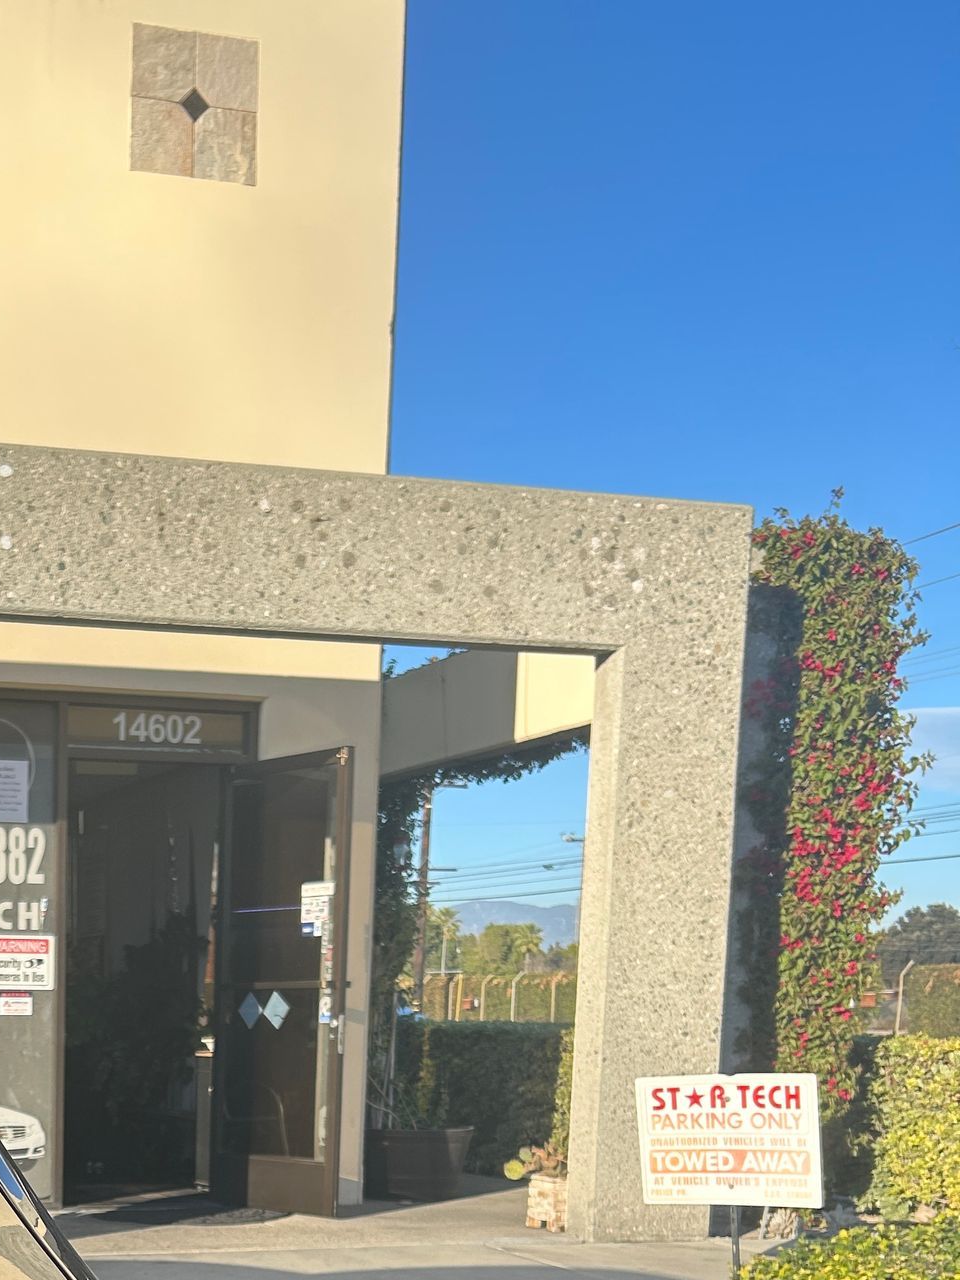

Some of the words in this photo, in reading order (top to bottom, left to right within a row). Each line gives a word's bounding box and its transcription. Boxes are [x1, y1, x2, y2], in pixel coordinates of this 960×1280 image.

[112, 712, 202, 744] 14602
[32, 971, 45, 983] Use
[736, 1085, 801, 1110] TECH
[651, 1112, 744, 1131] PARKING
[749, 1112, 802, 1131] ONLY
[650, 1137, 718, 1147] UNAUTHORIZED
[723, 1137, 765, 1147] VEHICLES
[770, 1137, 791, 1147] WILL
[651, 1151, 735, 1172] TOWED
[740, 1151, 807, 1173] AWAY
[654, 1176, 665, 1186] AT
[671, 1176, 710, 1186] VEHICLE
[716, 1176, 760, 1187] OWNER'S
